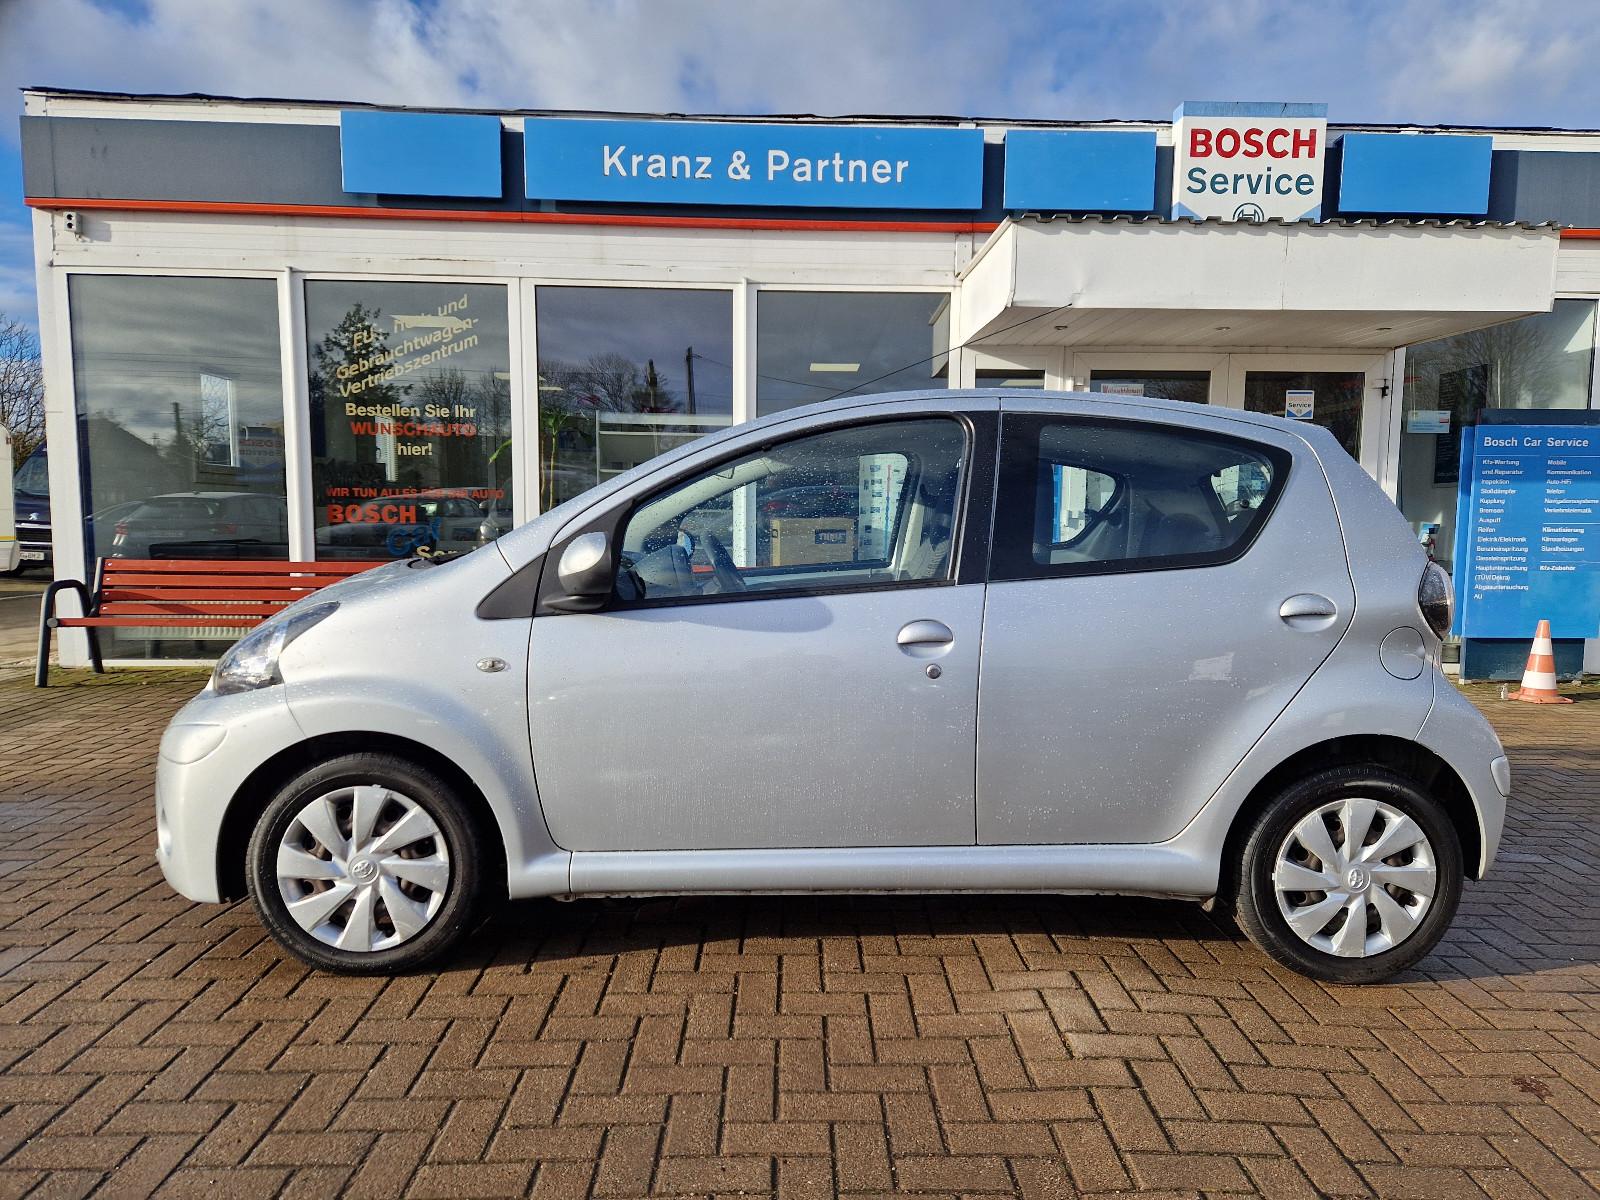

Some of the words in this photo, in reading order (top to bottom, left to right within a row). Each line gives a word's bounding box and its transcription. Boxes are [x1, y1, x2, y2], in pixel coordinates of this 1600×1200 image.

[1189, 127, 1317, 159] BOSCH
[603, 145, 712, 179] Kranz
[727, 150, 751, 180] &
[767, 149, 909, 183] Partner
[1186, 166, 1315, 195] Service
[438, 293, 468, 317] und
[339, 334, 478, 398] Vertriebszentrum
[345, 402, 420, 417] Bestellen
[424, 403, 450, 418] Sie
[454, 404, 477, 418] Ihr
[350, 421, 477, 437] WUNSCHAUTO
[397, 442, 433, 456] hier!
[1483, 436, 1518, 447] Bosch
[1523, 437, 1542, 447] Car
[1547, 437, 1589, 447] Service
[326, 488, 350, 498] WIR
[352, 488, 377, 498] TUN
[380, 488, 417, 499] ALLES
[471, 489, 505, 499] AUTO
[327, 503, 417, 525] BOSCH
[1542, 526, 1585, 534] Klimatisierung
[1474, 583, 1529, 591] Abgasuntersuchung
